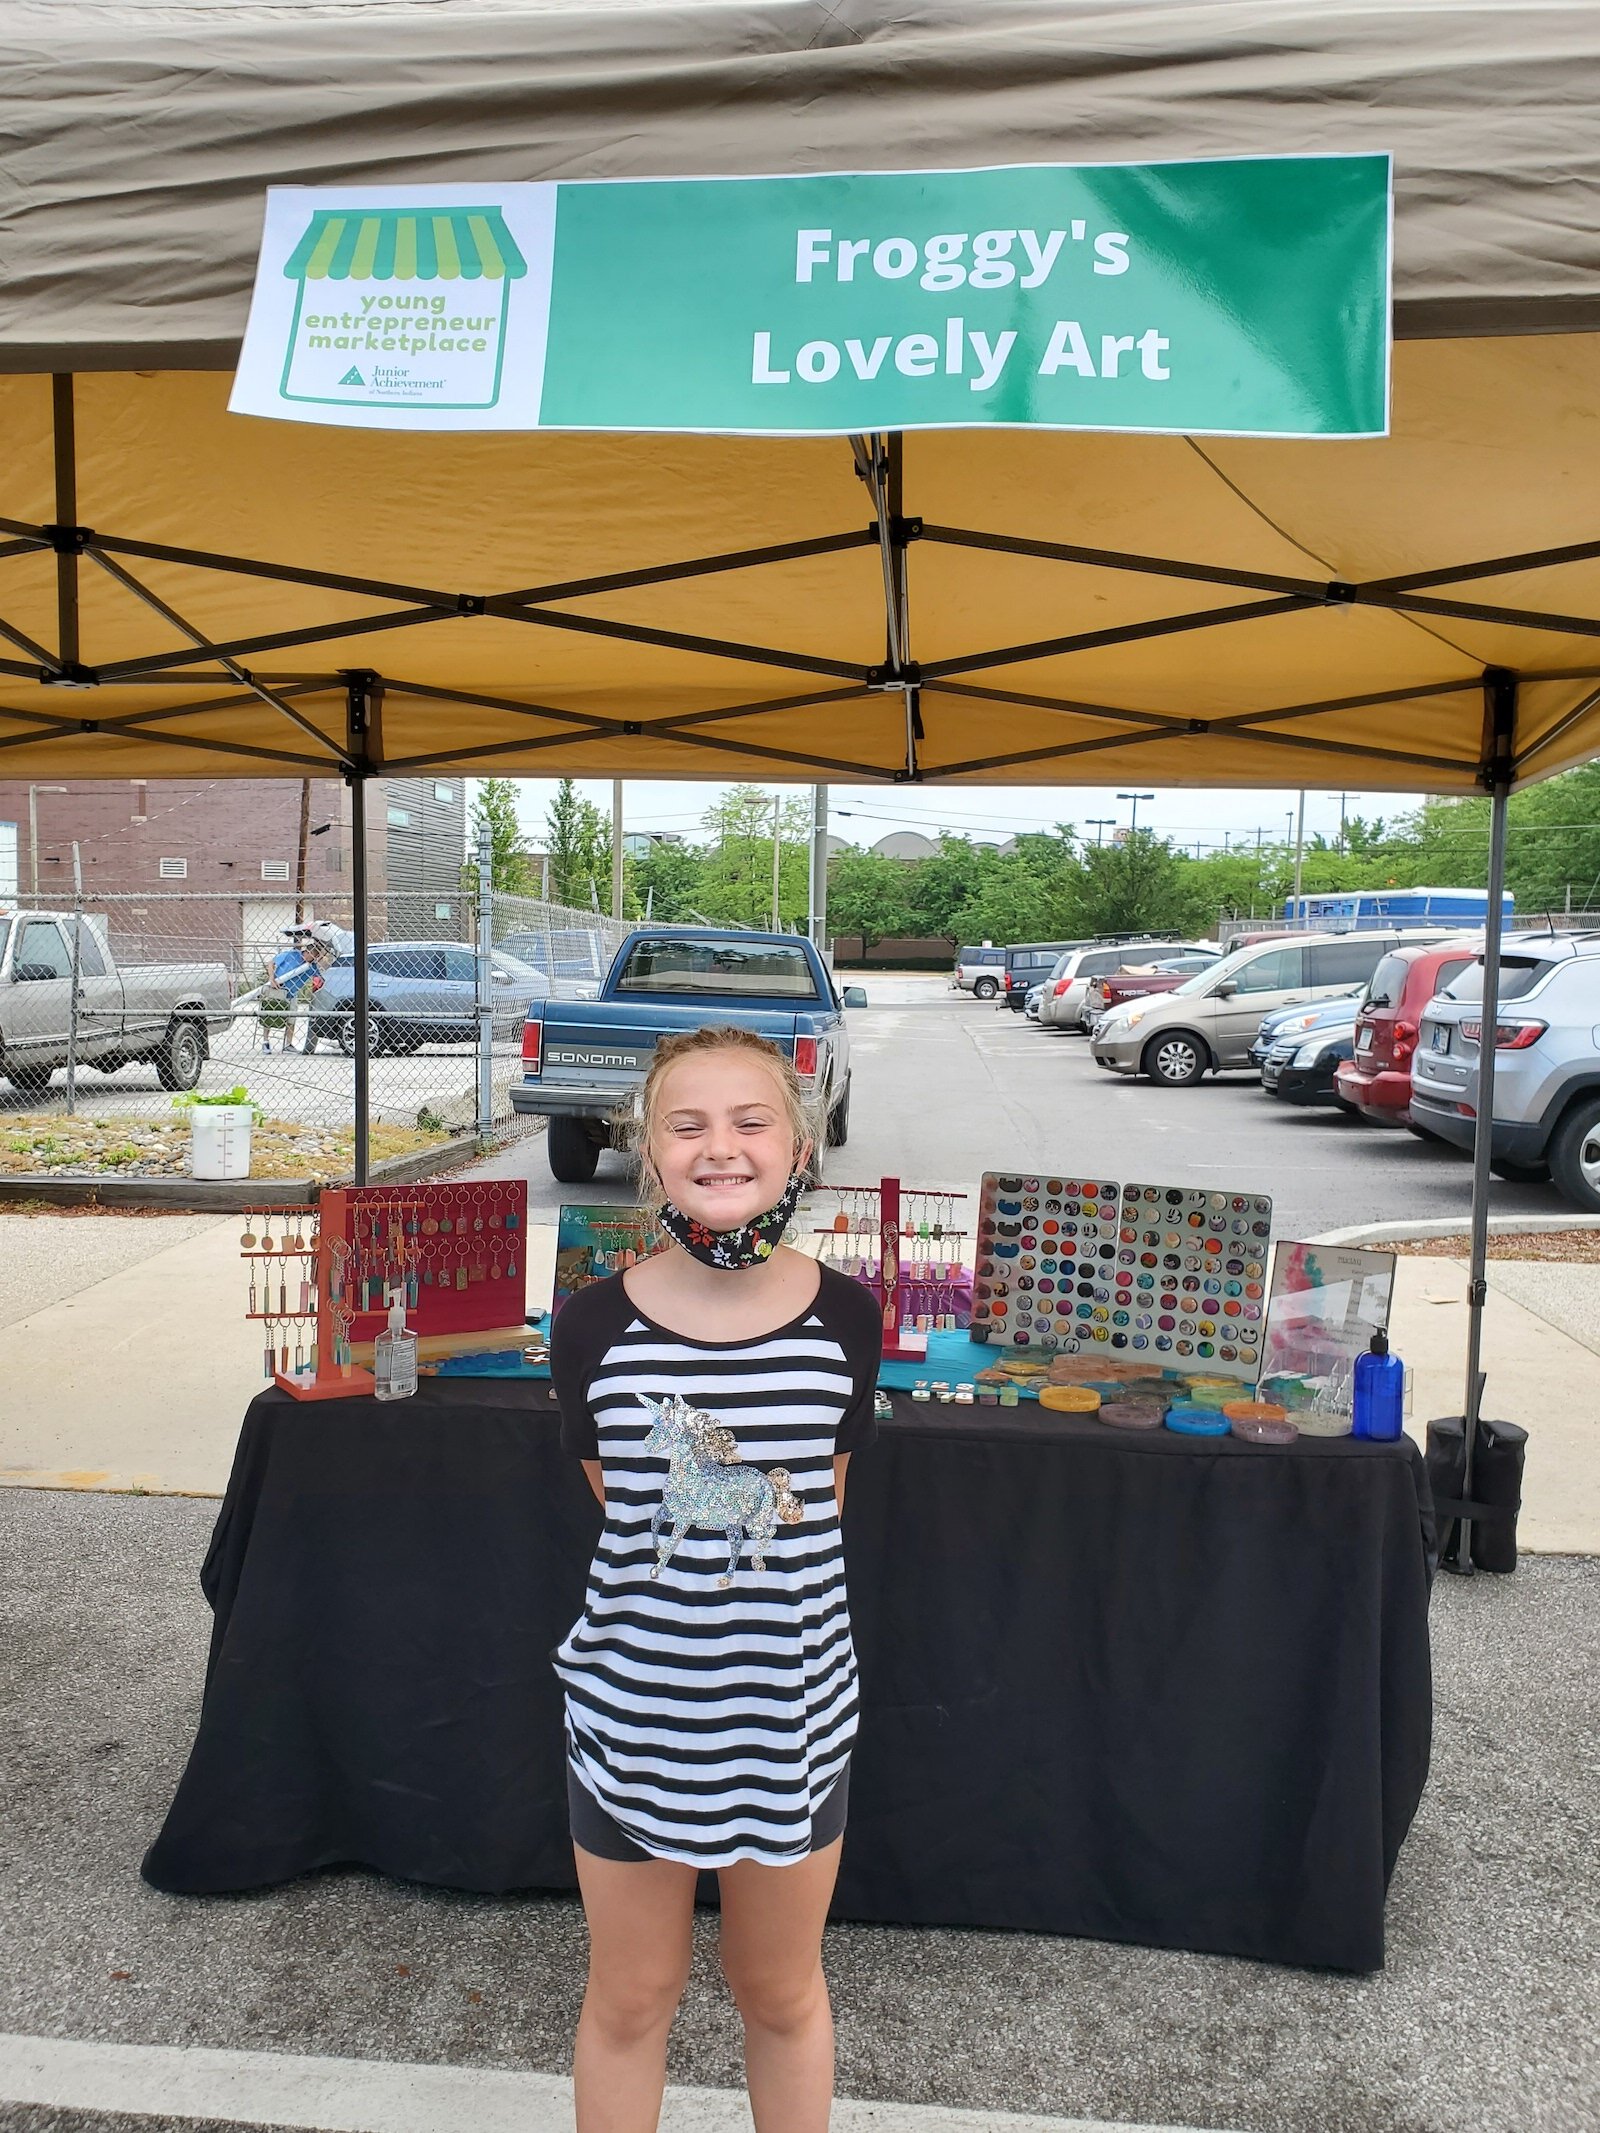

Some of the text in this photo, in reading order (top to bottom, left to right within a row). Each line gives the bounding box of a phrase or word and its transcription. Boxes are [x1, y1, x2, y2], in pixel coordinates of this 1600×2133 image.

[795, 219, 1130, 291] Froggy's
[360, 295, 446, 314] young
[305, 312, 496, 335] entrepreneur
[308, 332, 487, 356] marketplace
[751, 317, 1170, 391] Lovely Art
[371, 365, 410, 377] Junior
[370, 377, 444, 388] Achievement
[547, 1052, 637, 1066] SONOMA
